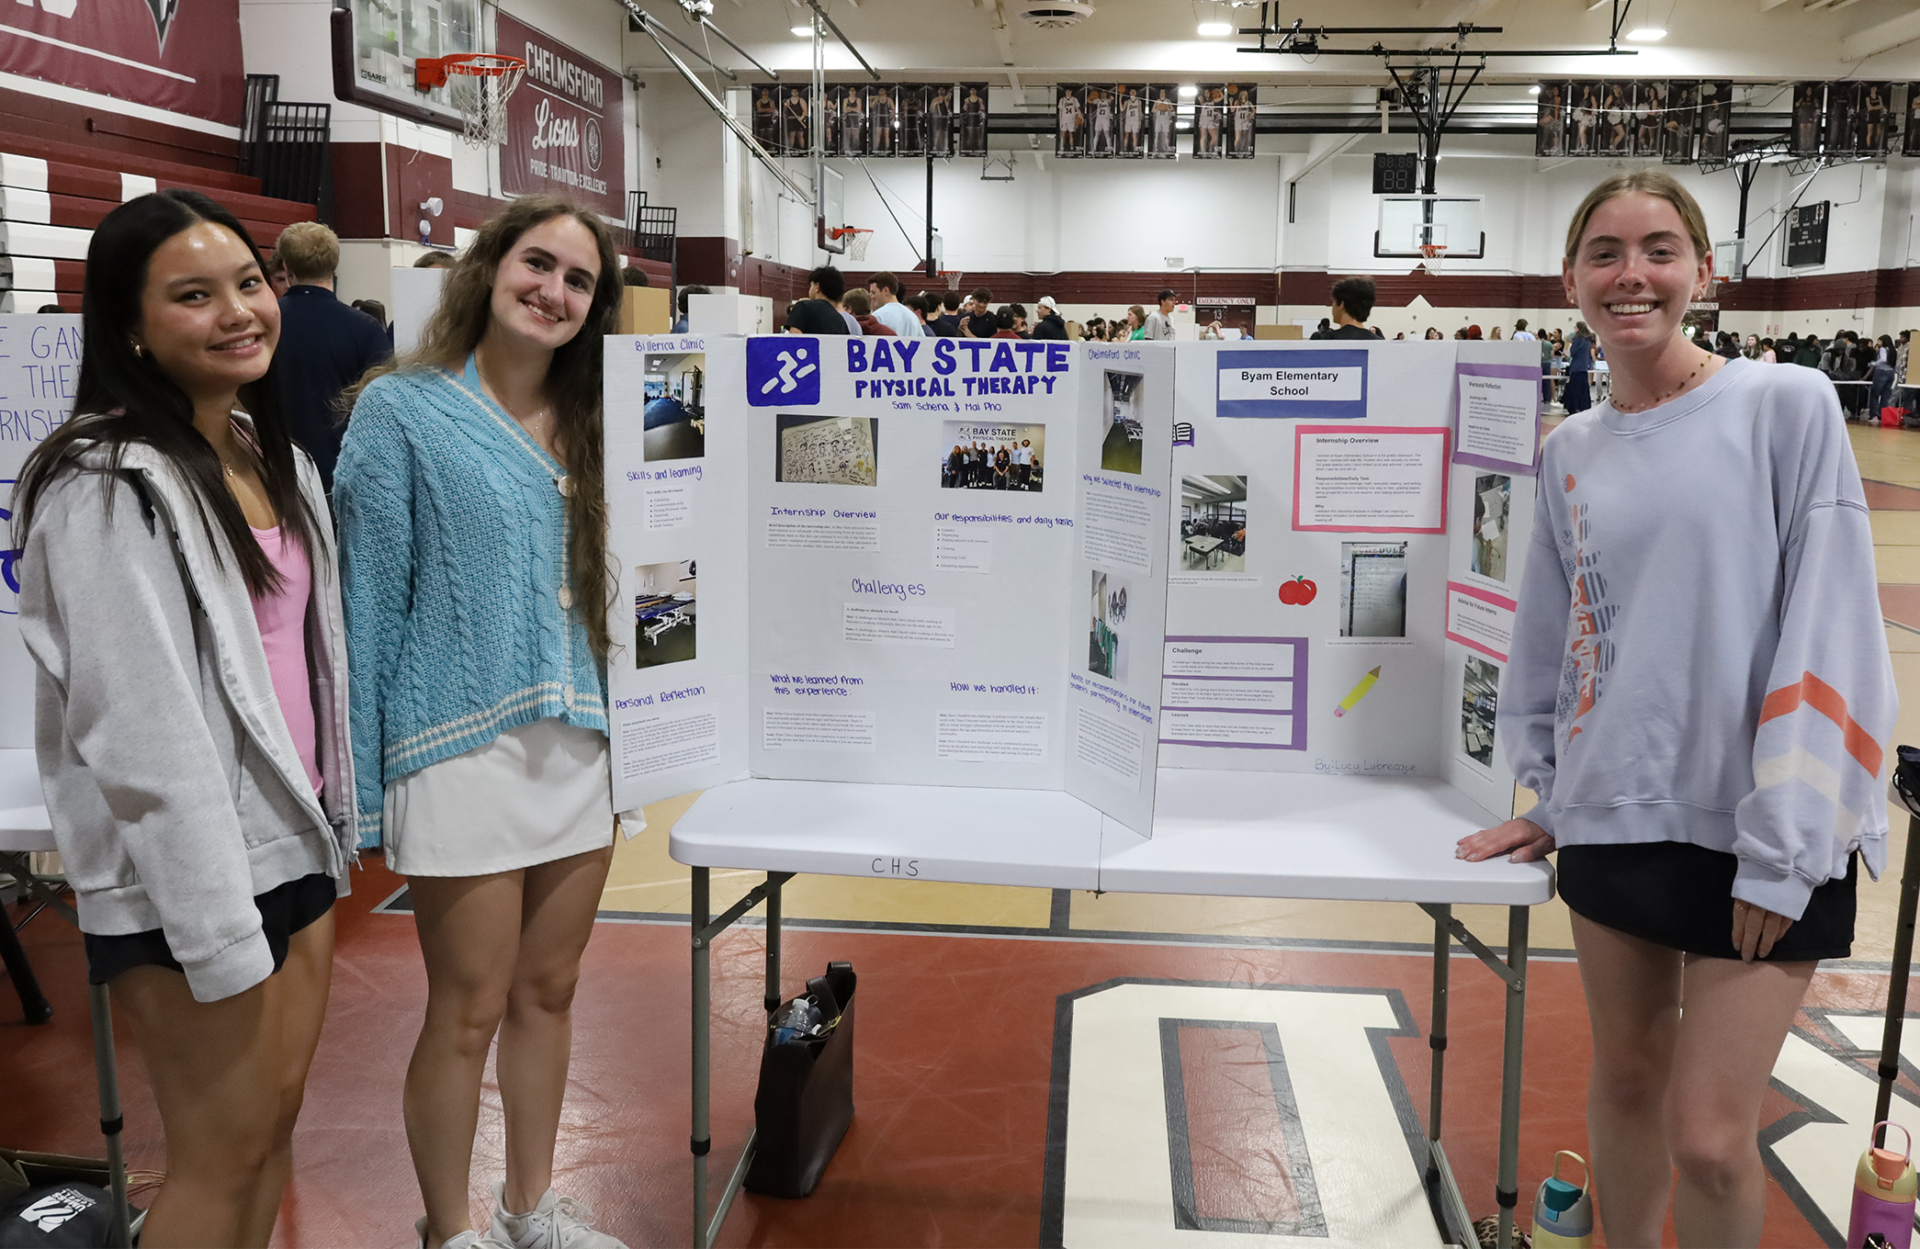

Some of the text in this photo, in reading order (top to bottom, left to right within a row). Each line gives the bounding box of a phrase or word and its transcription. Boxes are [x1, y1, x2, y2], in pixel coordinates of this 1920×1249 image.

[526, 41, 604, 108] CHELMSFORD
[532, 98, 580, 150] Lions
[530, 158, 548, 178] PRIDE
[1214, 310, 1222, 320] 13
[635, 339, 704, 352] Billerica Clinic
[847, 338, 1070, 376] BAY STATE
[1088, 349, 1120, 360] Chelmsford
[22, 365, 82, 398] THE
[1242, 370, 1338, 382] Byam Elementary
[855, 376, 1057, 398] PHYSICAL THERAPY
[1270, 386, 1308, 396] School
[892, 401, 912, 410] Sam
[916, 402, 950, 412] Schena
[966, 402, 980, 411] Mai
[984, 402, 1002, 412] Pho
[0, 409, 74, 442] RNSH
[973, 428, 1016, 436] BAY STATE
[626, 465, 702, 481] Skills and learning
[770, 506, 876, 518] Internship Overview
[934, 512, 1073, 528] Our responsibilities and daily tasks
[852, 578, 926, 601] Challenges
[805, 675, 838, 685] learned
[841, 676, 864, 685] from
[950, 682, 969, 691] How
[990, 684, 1026, 694] handled
[774, 686, 790, 695] this
[615, 694, 654, 710] Personal
[1335, 760, 1359, 774] Lucy
[872, 858, 918, 876] CHS
[52, 1192, 86, 1212] UMASS
